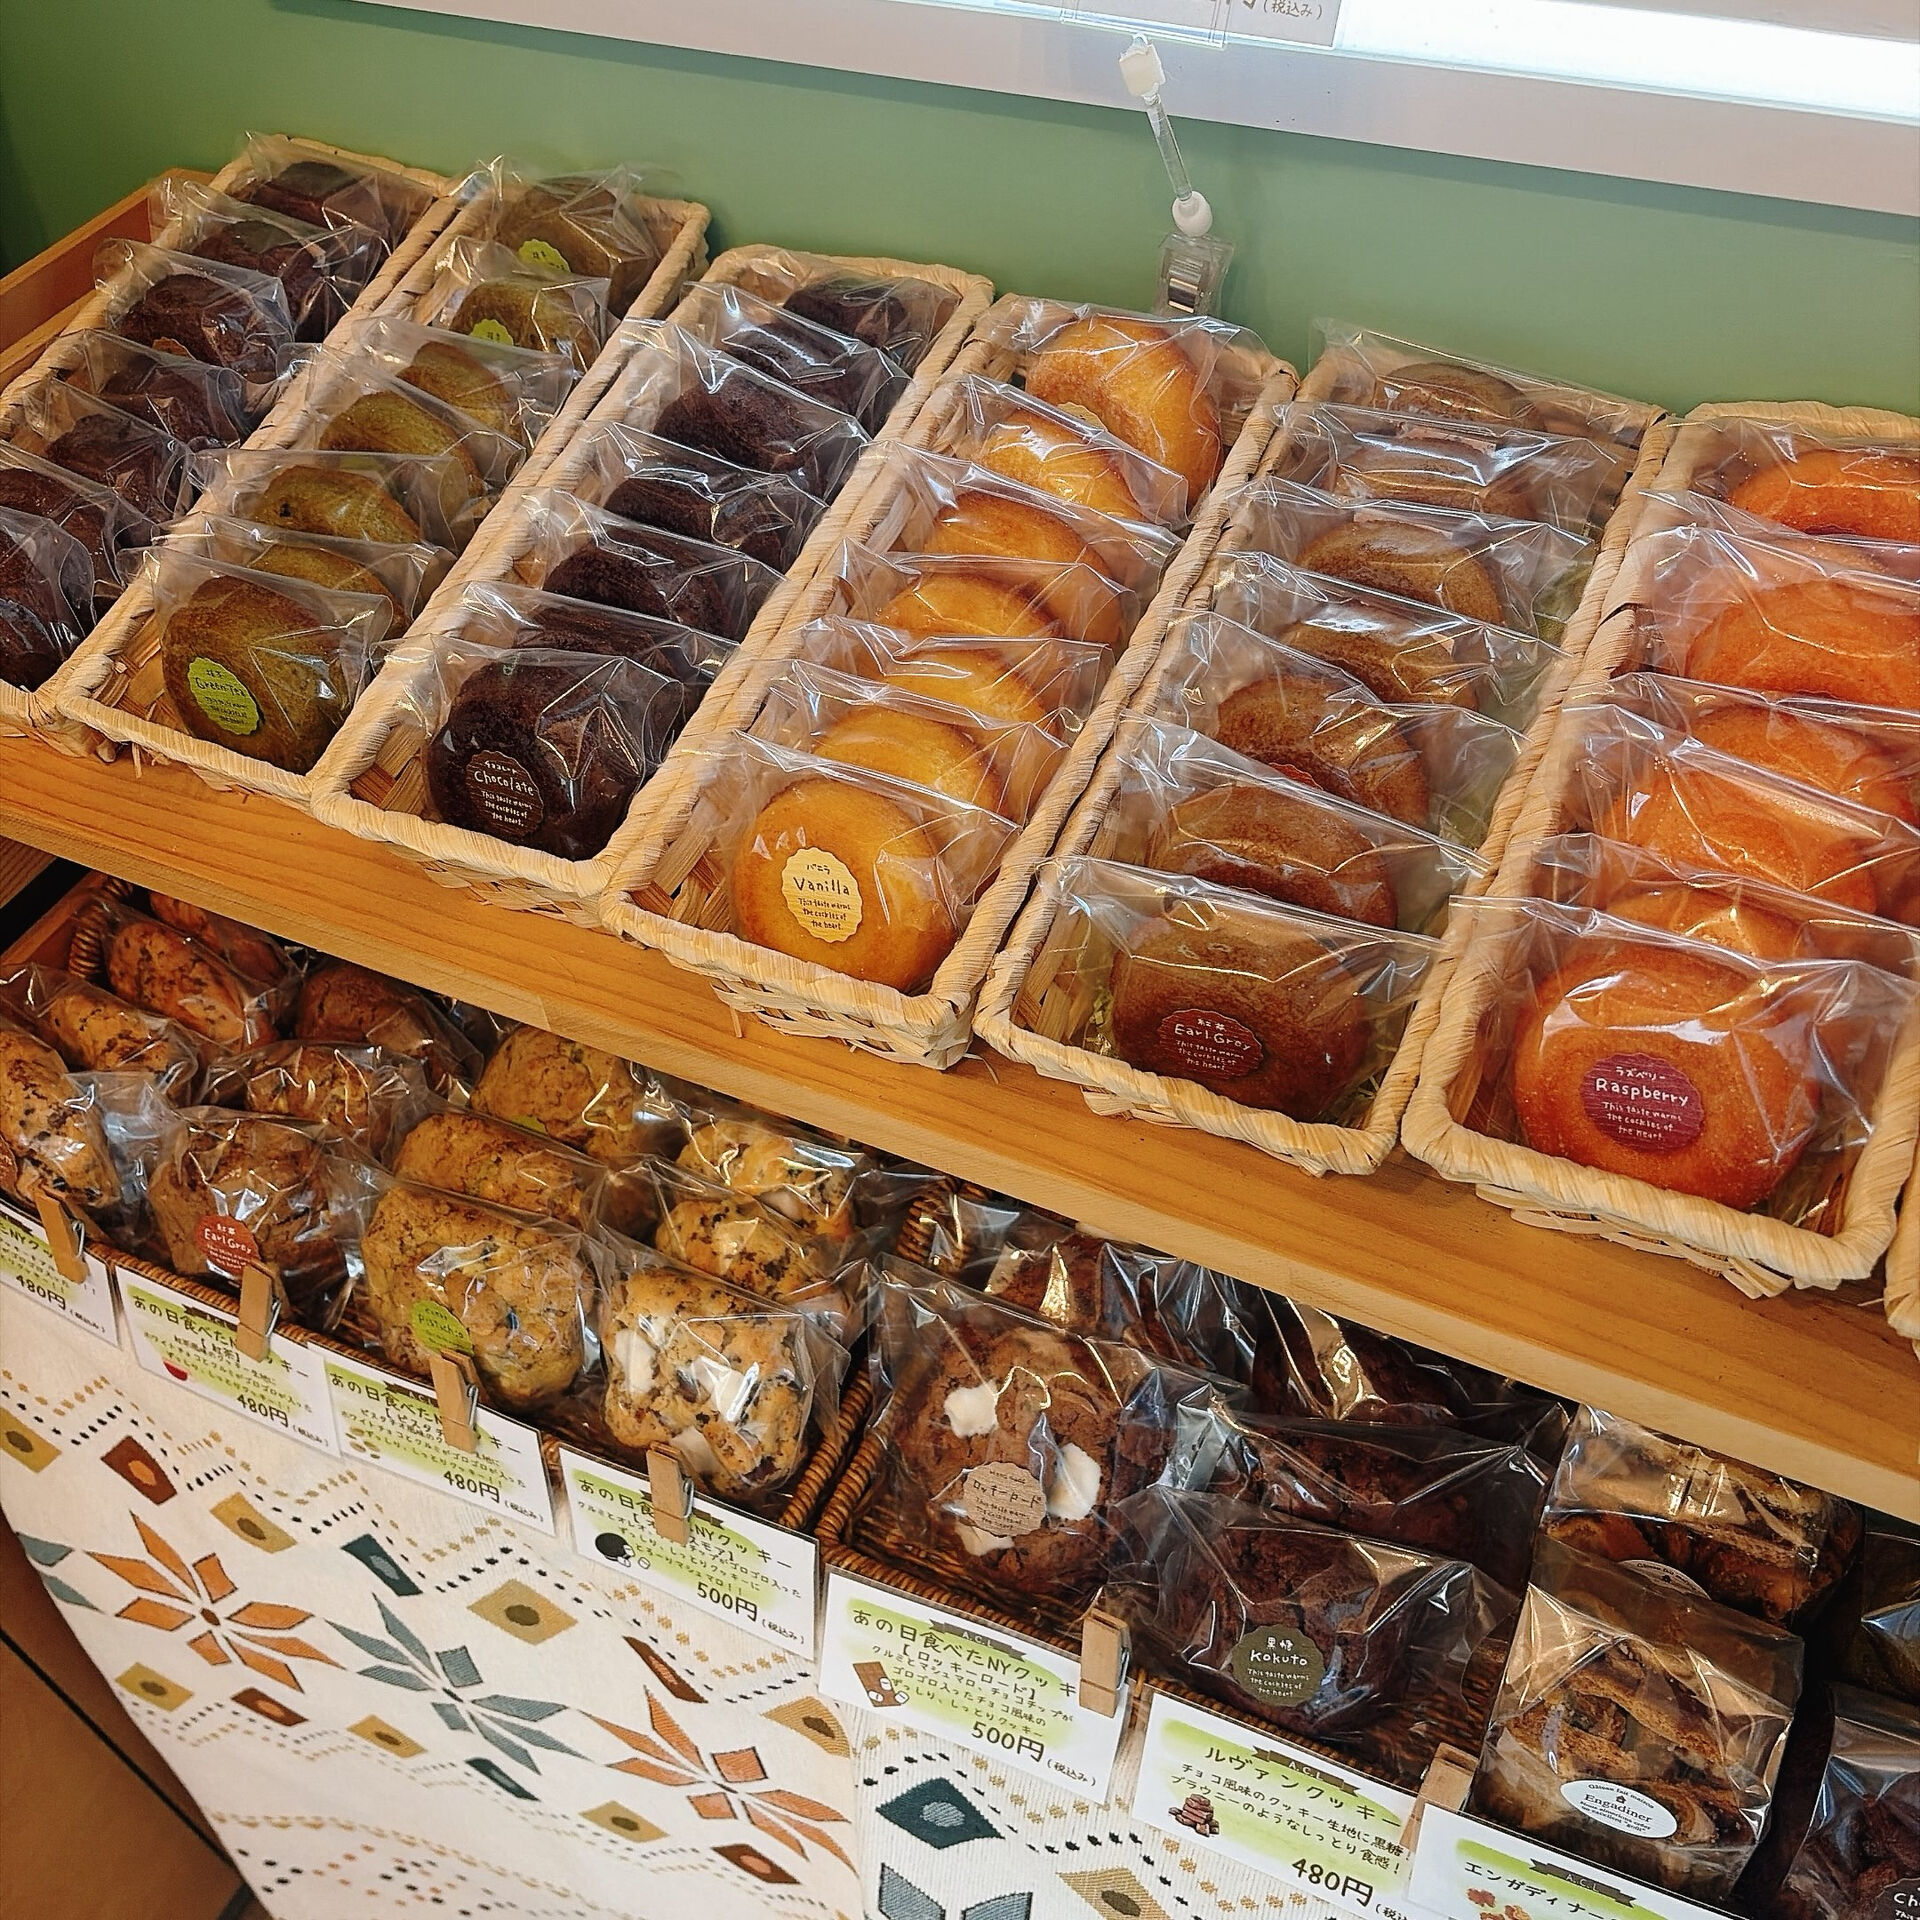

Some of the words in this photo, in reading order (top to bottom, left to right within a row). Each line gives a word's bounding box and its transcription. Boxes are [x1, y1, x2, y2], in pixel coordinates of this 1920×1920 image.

[226, 684, 246, 696] Tea
[474, 770, 535, 797] Chocolate
[806, 863, 831, 876] バニラ
[792, 876, 851, 896] Vanilla
[1174, 1023, 1210, 1040] Earl
[1615, 1065, 1667, 1081] ラズベリー
[1595, 1077, 1690, 1108] Raspberry
[1602, 1101, 1624, 1113] This
[1625, 1105, 1652, 1117] taste
[1652, 1111, 1683, 1122] warms
[1606, 1112, 1623, 1123] the
[1663, 1123, 1675, 1133] of
[204, 1227, 226, 1245] Earl
[226, 1237, 253, 1255] Grey
[15, 1274, 67, 1311] 480円
[236, 1393, 290, 1428] 480円
[385, 1407, 444, 1437] 【ピスタチ
[443, 1470, 500, 1504] 480円
[972, 1479, 1043, 1509] ロッキーロード
[578, 1478, 793, 1570] あの日食NYクッキー
[697, 1581, 759, 1623] 500円
[762, 1619, 805, 1645] (税込み)
[1267, 1636, 1294, 1651] 黒糖
[852, 1608, 1077, 1697] あの日食べたNYクッキ
[1250, 1649, 1308, 1667] Kokuto
[902, 1643, 1036, 1700] 【ロッキーロード】
[1247, 1667, 1264, 1677] This
[1265, 1671, 1285, 1680] taste
[1285, 1673, 1310, 1681] warms
[892, 1665, 1047, 1728] ゴロゴロ入ったチョコ風味の
[971, 1720, 1045, 1763] 500円
[1047, 1758, 1097, 1788] (税込み)
[1205, 1747, 1401, 1828] ルヴァンクッキー
[1584, 1793, 1654, 1824] Engadiner
[1291, 1858, 1373, 1907] 480円
[1464, 1861, 1612, 1920] エンガディナー
[1893, 1892, 1920, 1907] Ch
